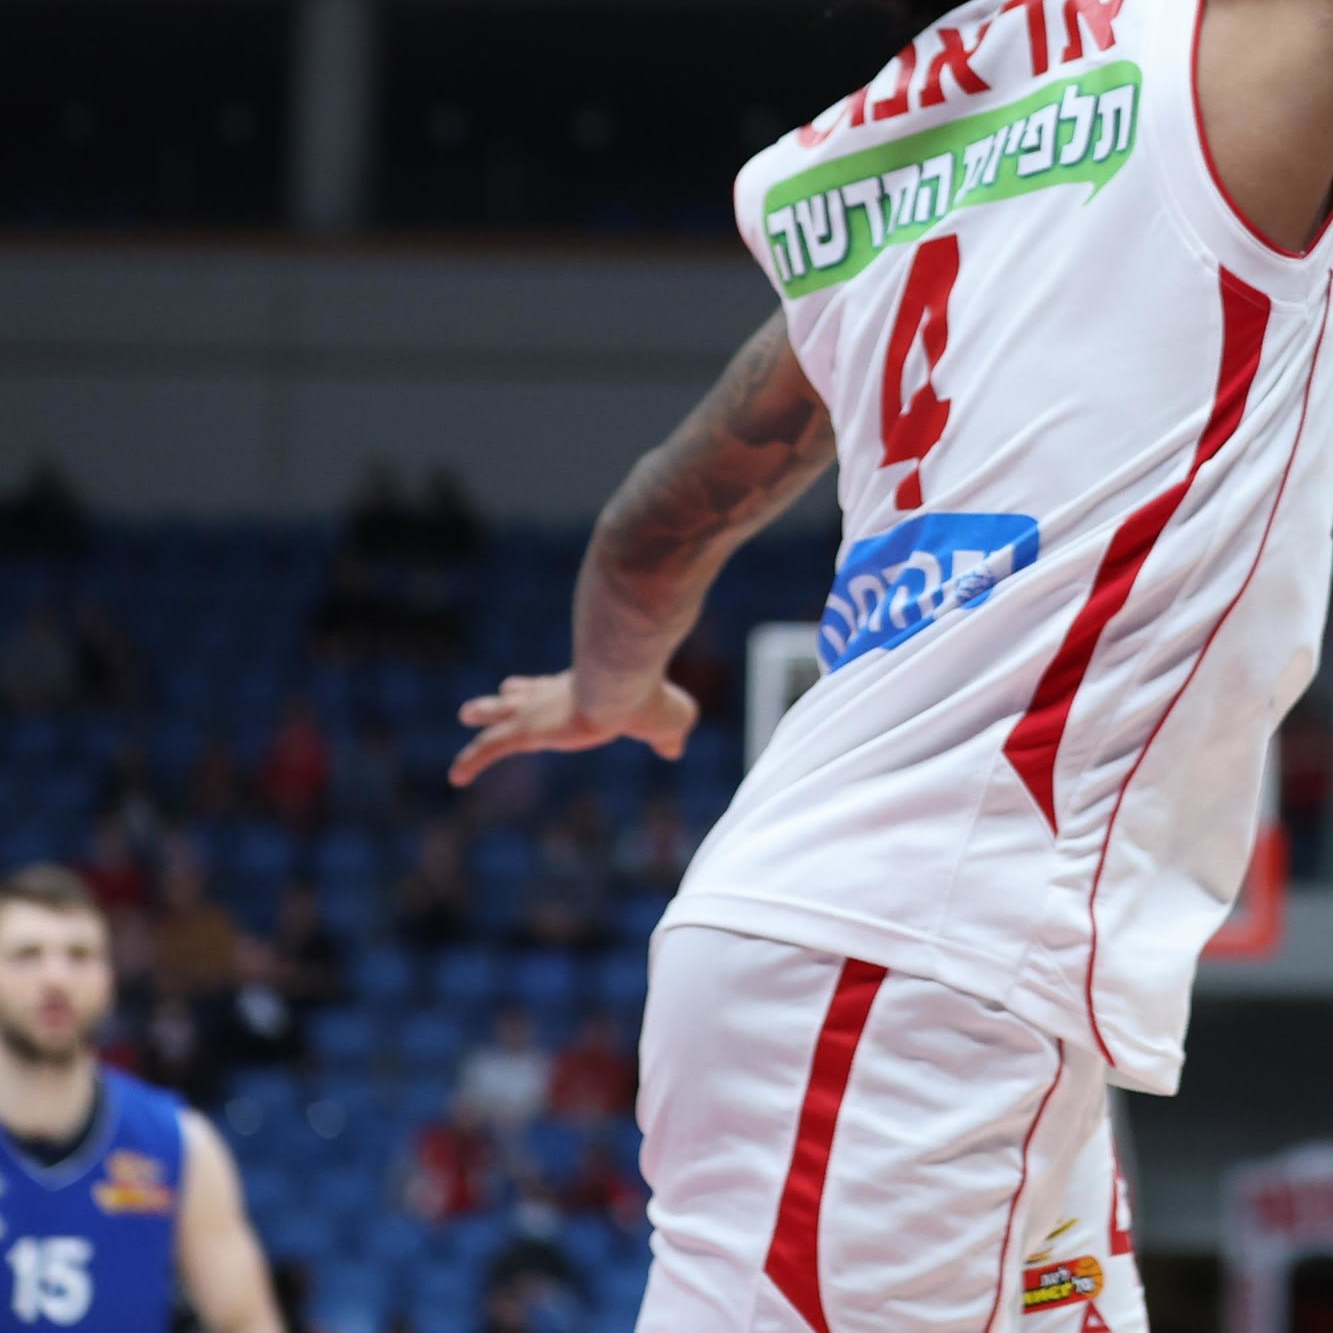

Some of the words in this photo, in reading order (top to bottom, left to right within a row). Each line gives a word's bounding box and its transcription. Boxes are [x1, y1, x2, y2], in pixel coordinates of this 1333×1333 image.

[954, 84, 1135, 204] תלפיות
[767, 152, 955, 282] החדשה
[878, 233, 960, 510] 4
[6, 1236, 95, 1325] 15
